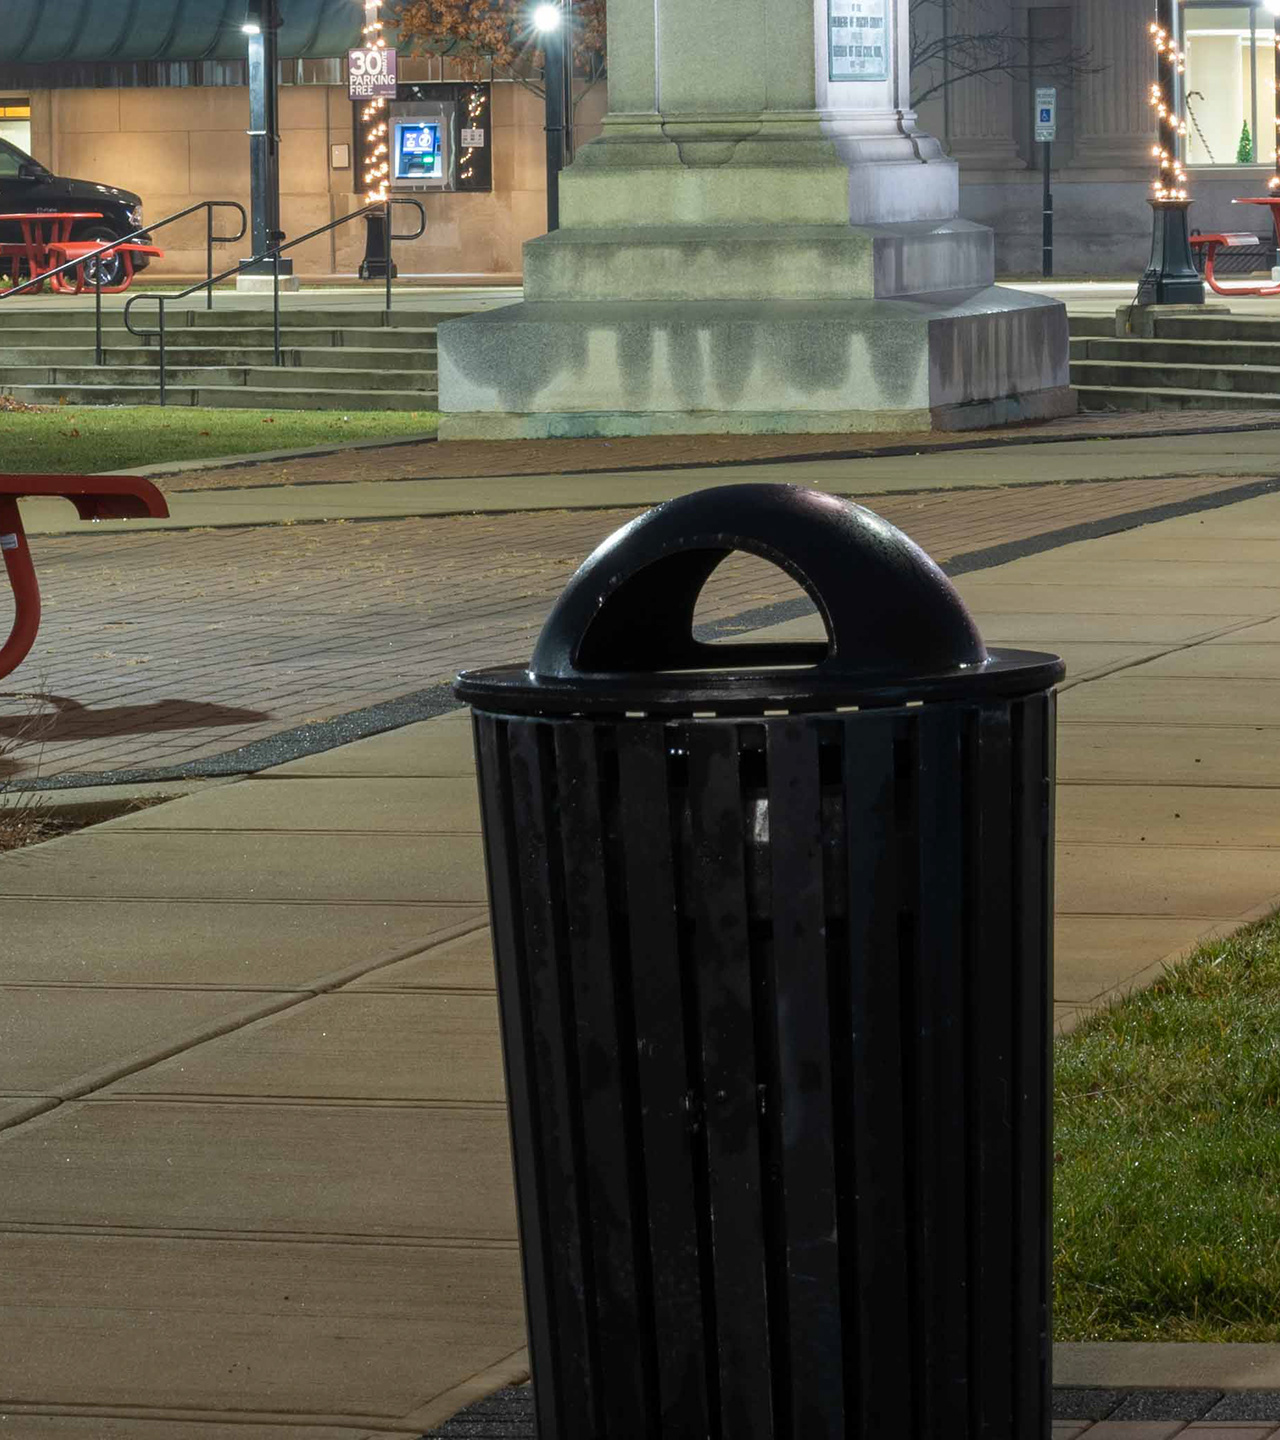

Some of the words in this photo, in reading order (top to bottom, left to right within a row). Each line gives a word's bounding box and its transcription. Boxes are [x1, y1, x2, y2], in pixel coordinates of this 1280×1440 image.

[350, 51, 381, 75] 30
[350, 75, 396, 85] PARKING
[350, 85, 374, 95] FREE
